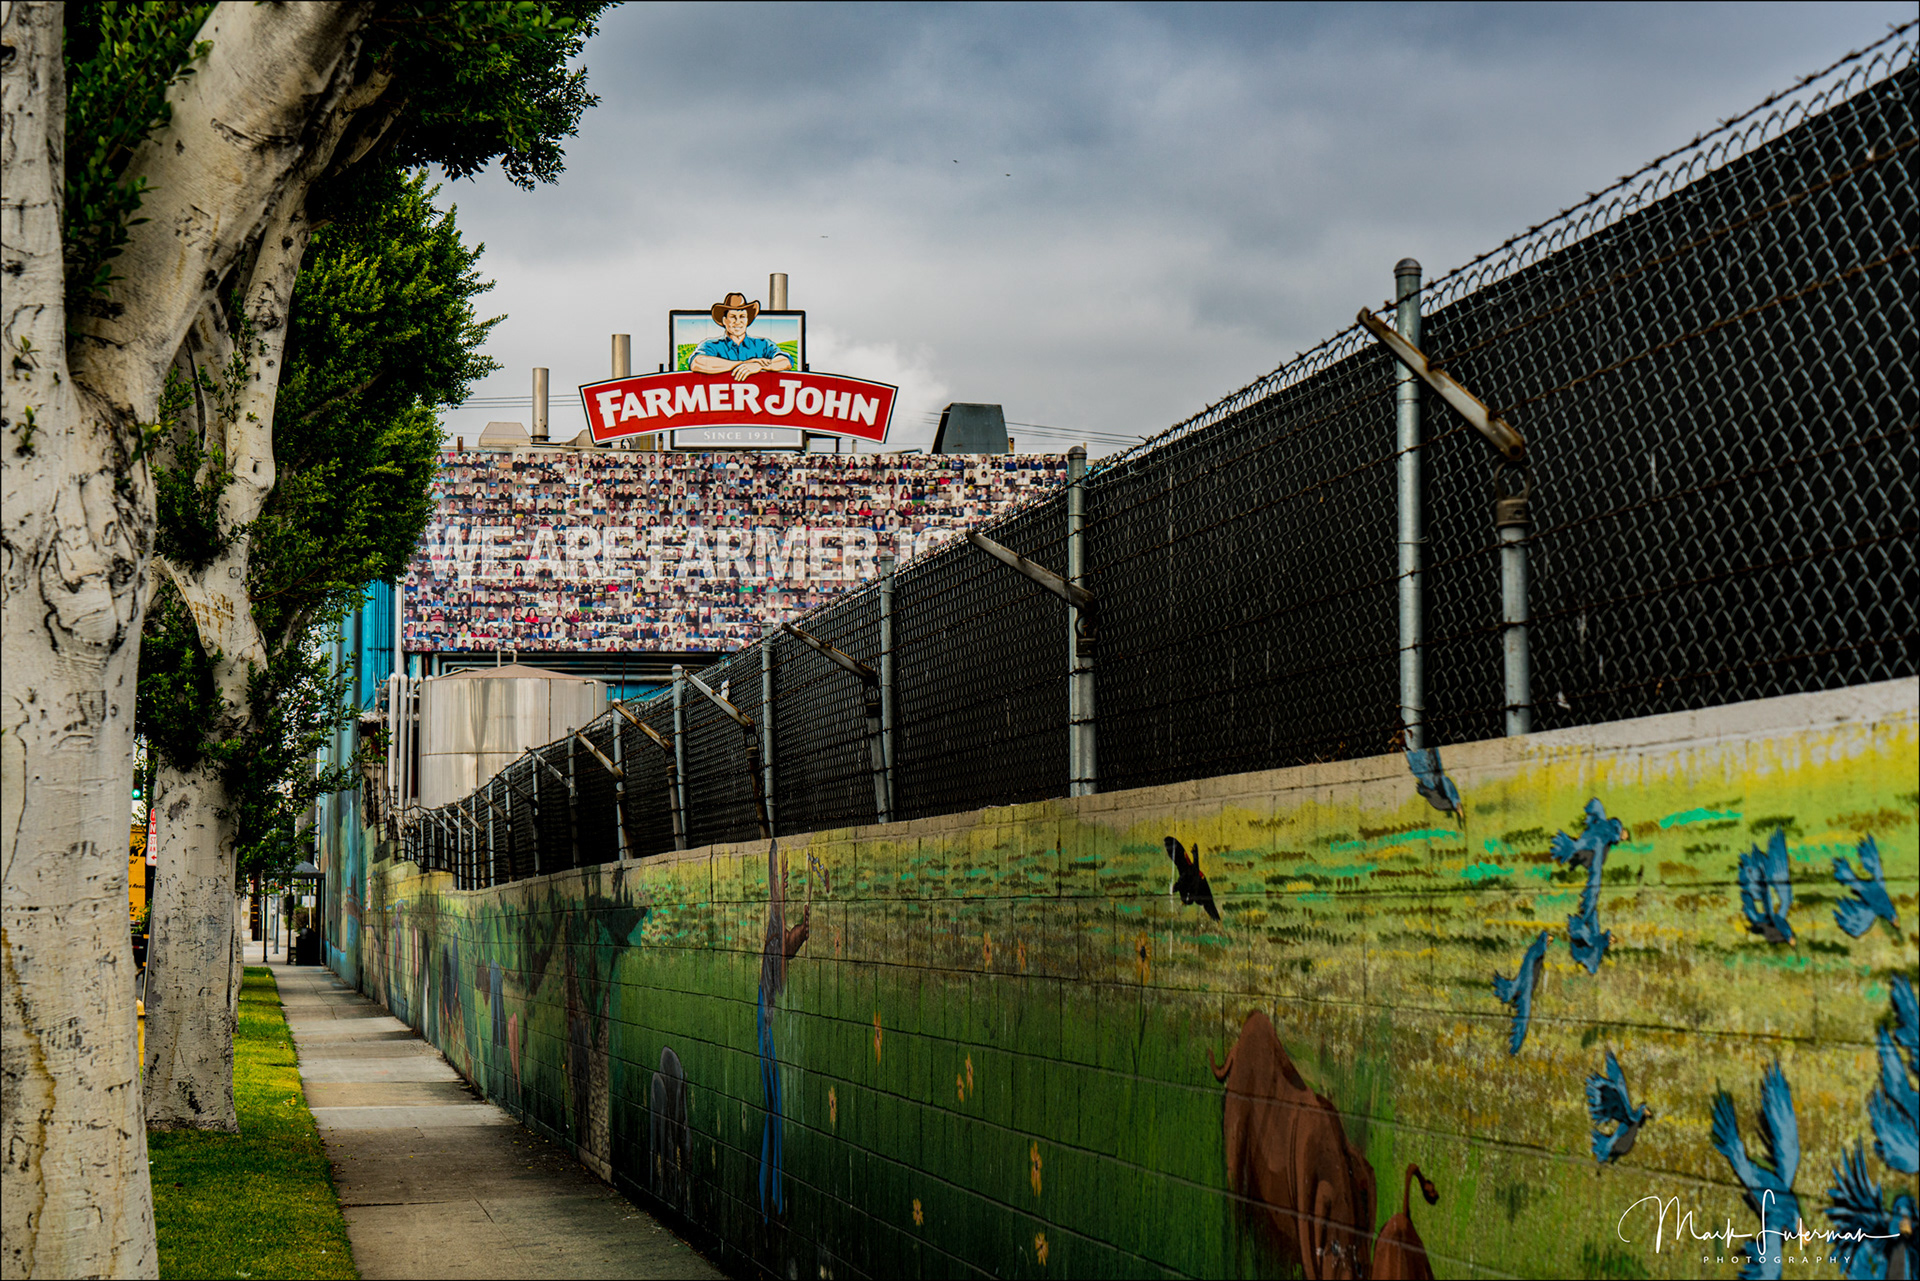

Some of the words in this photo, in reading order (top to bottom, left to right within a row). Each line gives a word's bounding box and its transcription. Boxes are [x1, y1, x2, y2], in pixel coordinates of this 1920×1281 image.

[596, 382, 762, 429] FARMER
[764, 379, 880, 427] JOHN
[703, 430, 742, 441] SINCE
[748, 431, 775, 441] 1931
[425, 526, 515, 580] WE
[523, 526, 635, 580] ARE
[649, 526, 881, 581] FARMER
